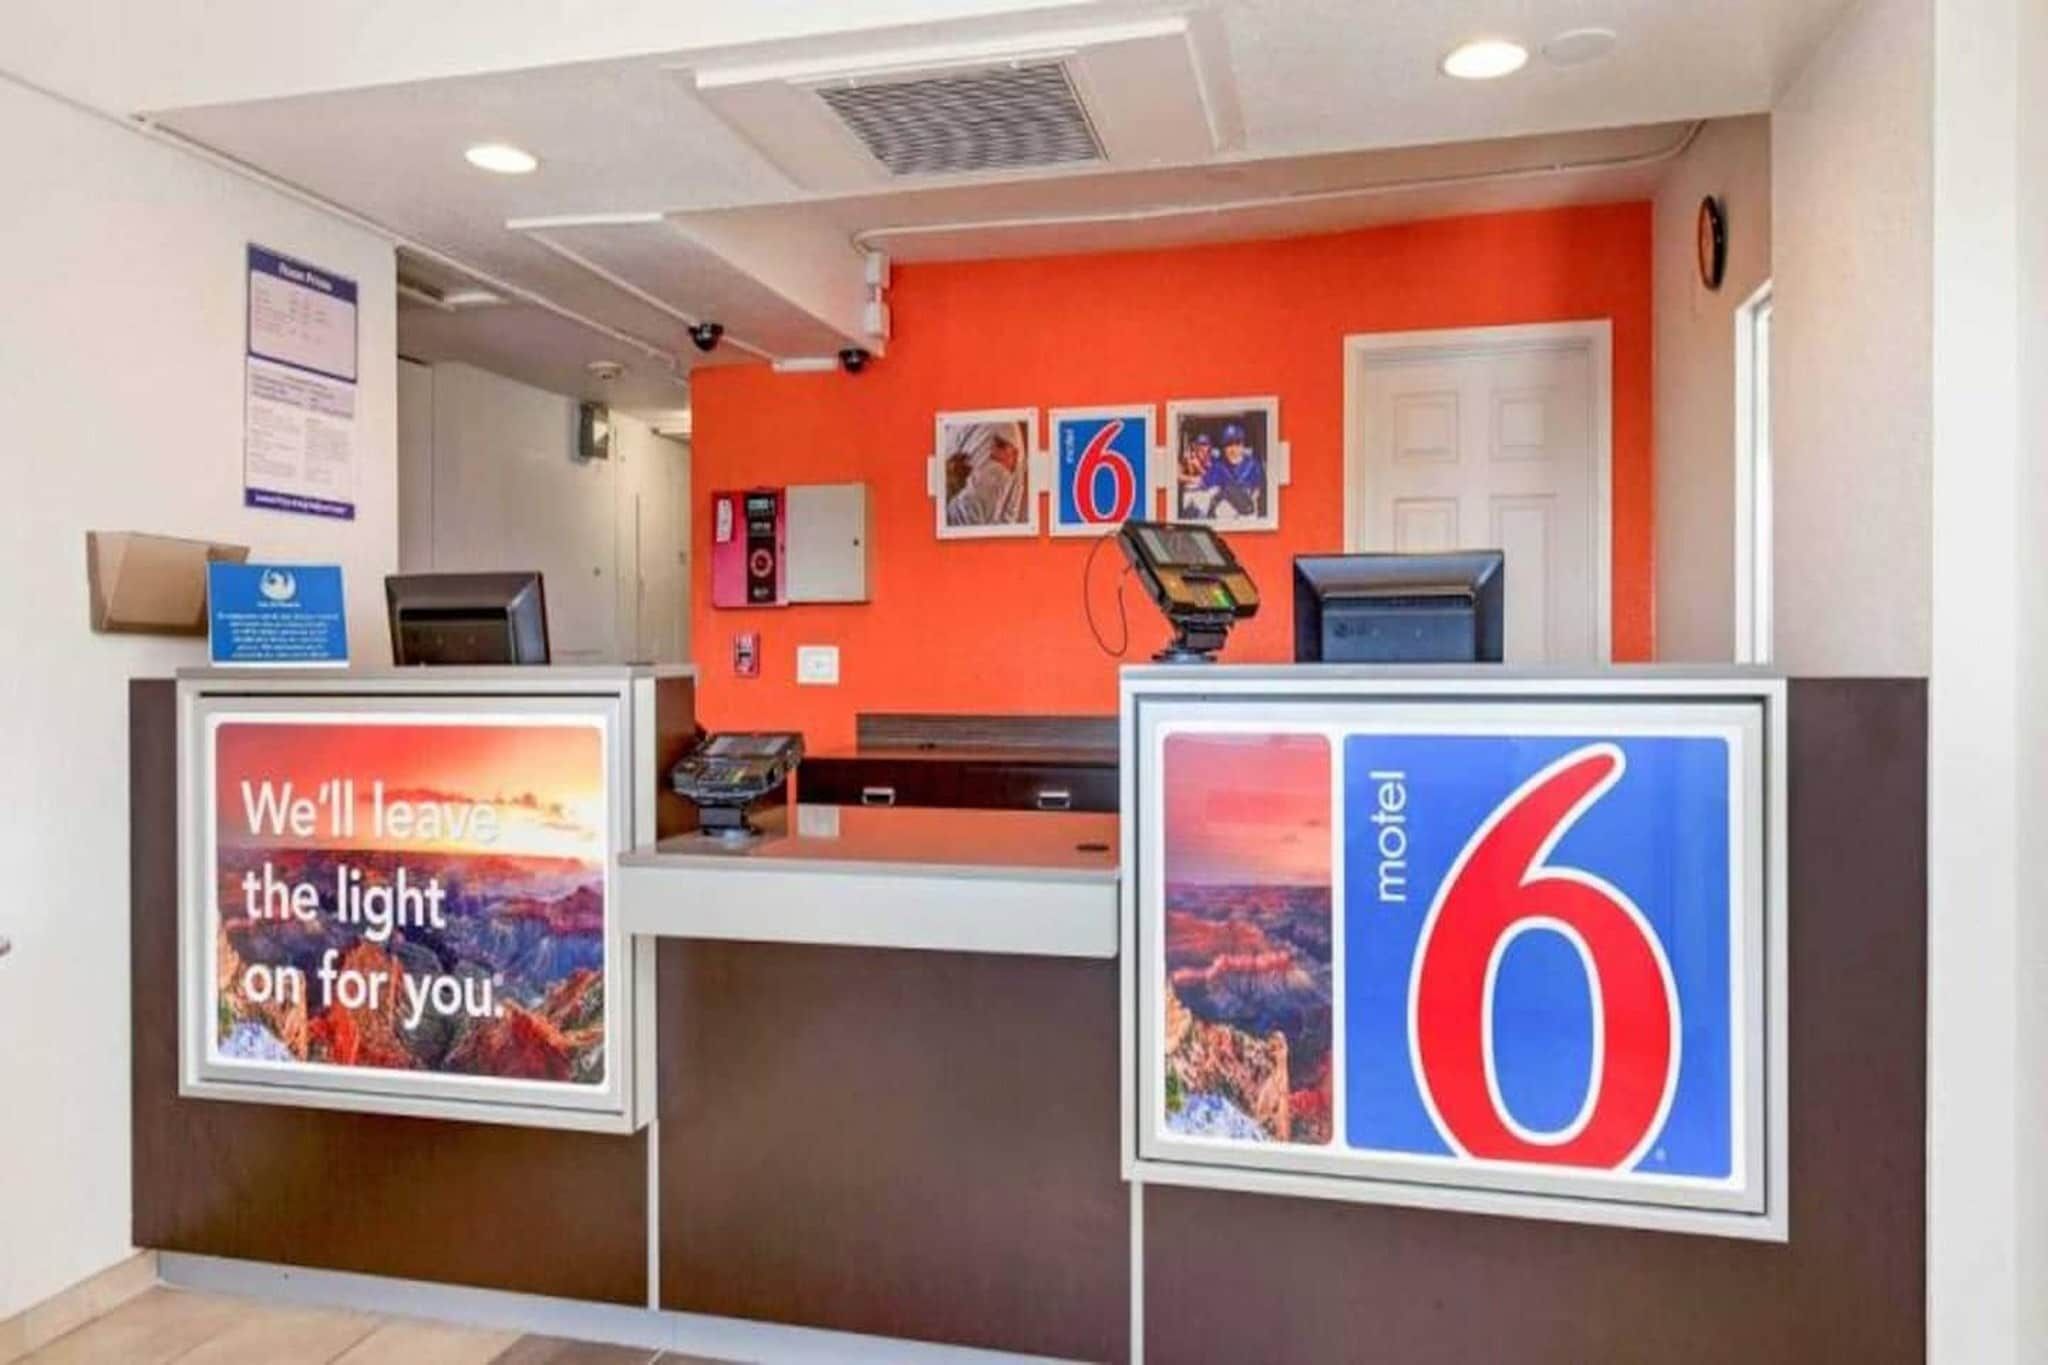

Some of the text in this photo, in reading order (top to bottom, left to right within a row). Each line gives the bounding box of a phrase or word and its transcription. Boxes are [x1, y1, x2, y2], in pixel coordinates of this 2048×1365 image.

[1073, 418, 1136, 524] 6
[241, 779, 498, 844] We'll leave
[242, 862, 447, 941] the light
[243, 963, 301, 1004] on
[317, 948, 389, 1010] for
[1369, 742, 1682, 1173] motel 6
